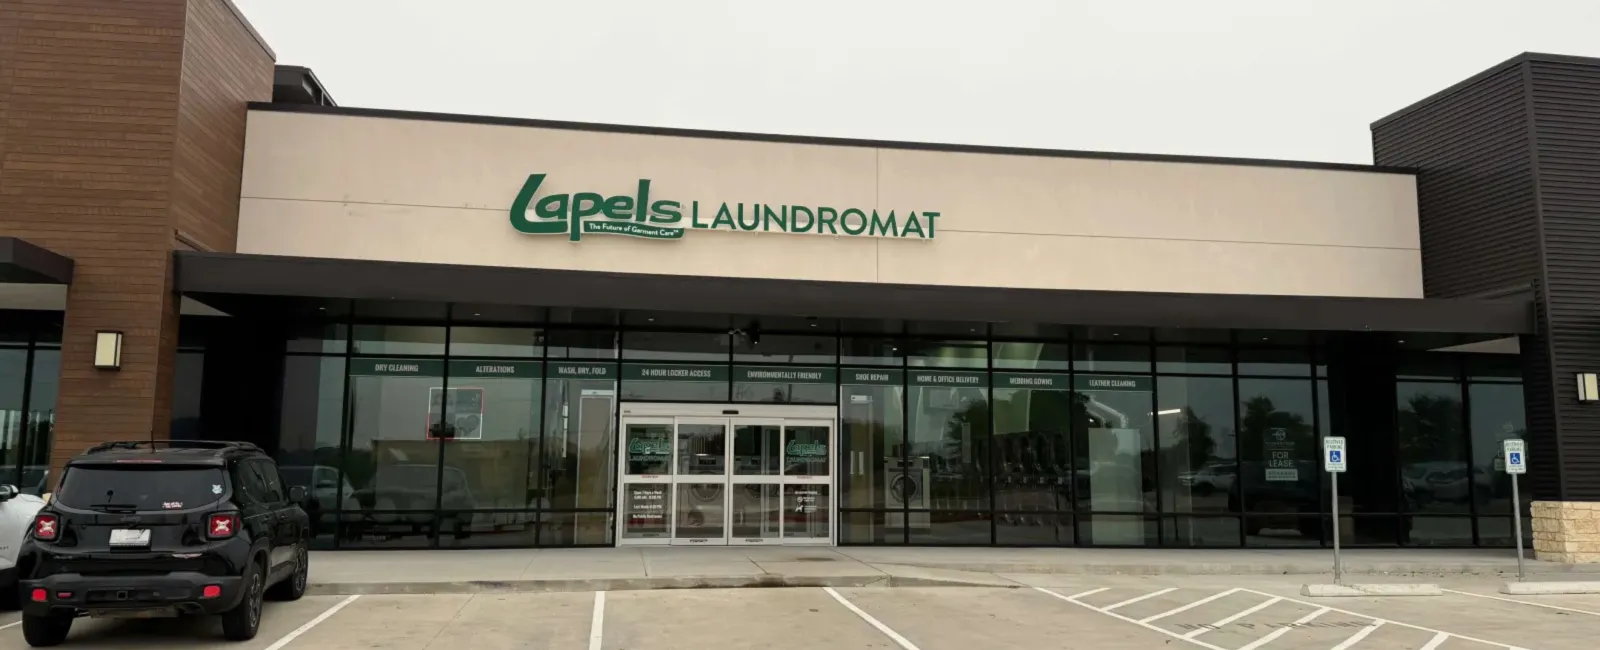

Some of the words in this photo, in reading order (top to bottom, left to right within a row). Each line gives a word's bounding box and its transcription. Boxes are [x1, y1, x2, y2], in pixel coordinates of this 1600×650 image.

[509, 173, 682, 242] Lapels
[692, 200, 940, 239] LAUNDROMAT
[589, 222, 600, 230] The
[602, 224, 622, 232] Future
[631, 226, 658, 236] Garment
[375, 363, 388, 372] DRY
[388, 363, 419, 372] CLEANING
[475, 365, 515, 374] ALTERATIONS
[558, 366, 576, 375] WASH,
[592, 367, 607, 375] FOLD
[641, 368, 649, 376] 24
[650, 368, 667, 377] HOUR
[667, 369, 689, 377] LOCKER
[689, 369, 711, 378] ACCESS
[747, 370, 796, 379] ENVIRONMENTALLY
[797, 371, 822, 380] FRIENDLY
[855, 373, 869, 381] SHOE
[870, 373, 889, 381] REPAIR
[917, 375, 933, 383] HOME
[937, 375, 955, 384] OFFICE
[955, 376, 979, 384] DELIVERY
[1009, 377, 1033, 385] WEDDING
[1033, 377, 1053, 385] GOWNS
[1089, 379, 1110, 387] LEATHER
[1111, 380, 1136, 388] CLEANING
[629, 437, 672, 455] Lapels
[787, 439, 827, 456] Lapels
[1272, 451, 1289, 459] FOR
[1269, 459, 1293, 468] LEASE
